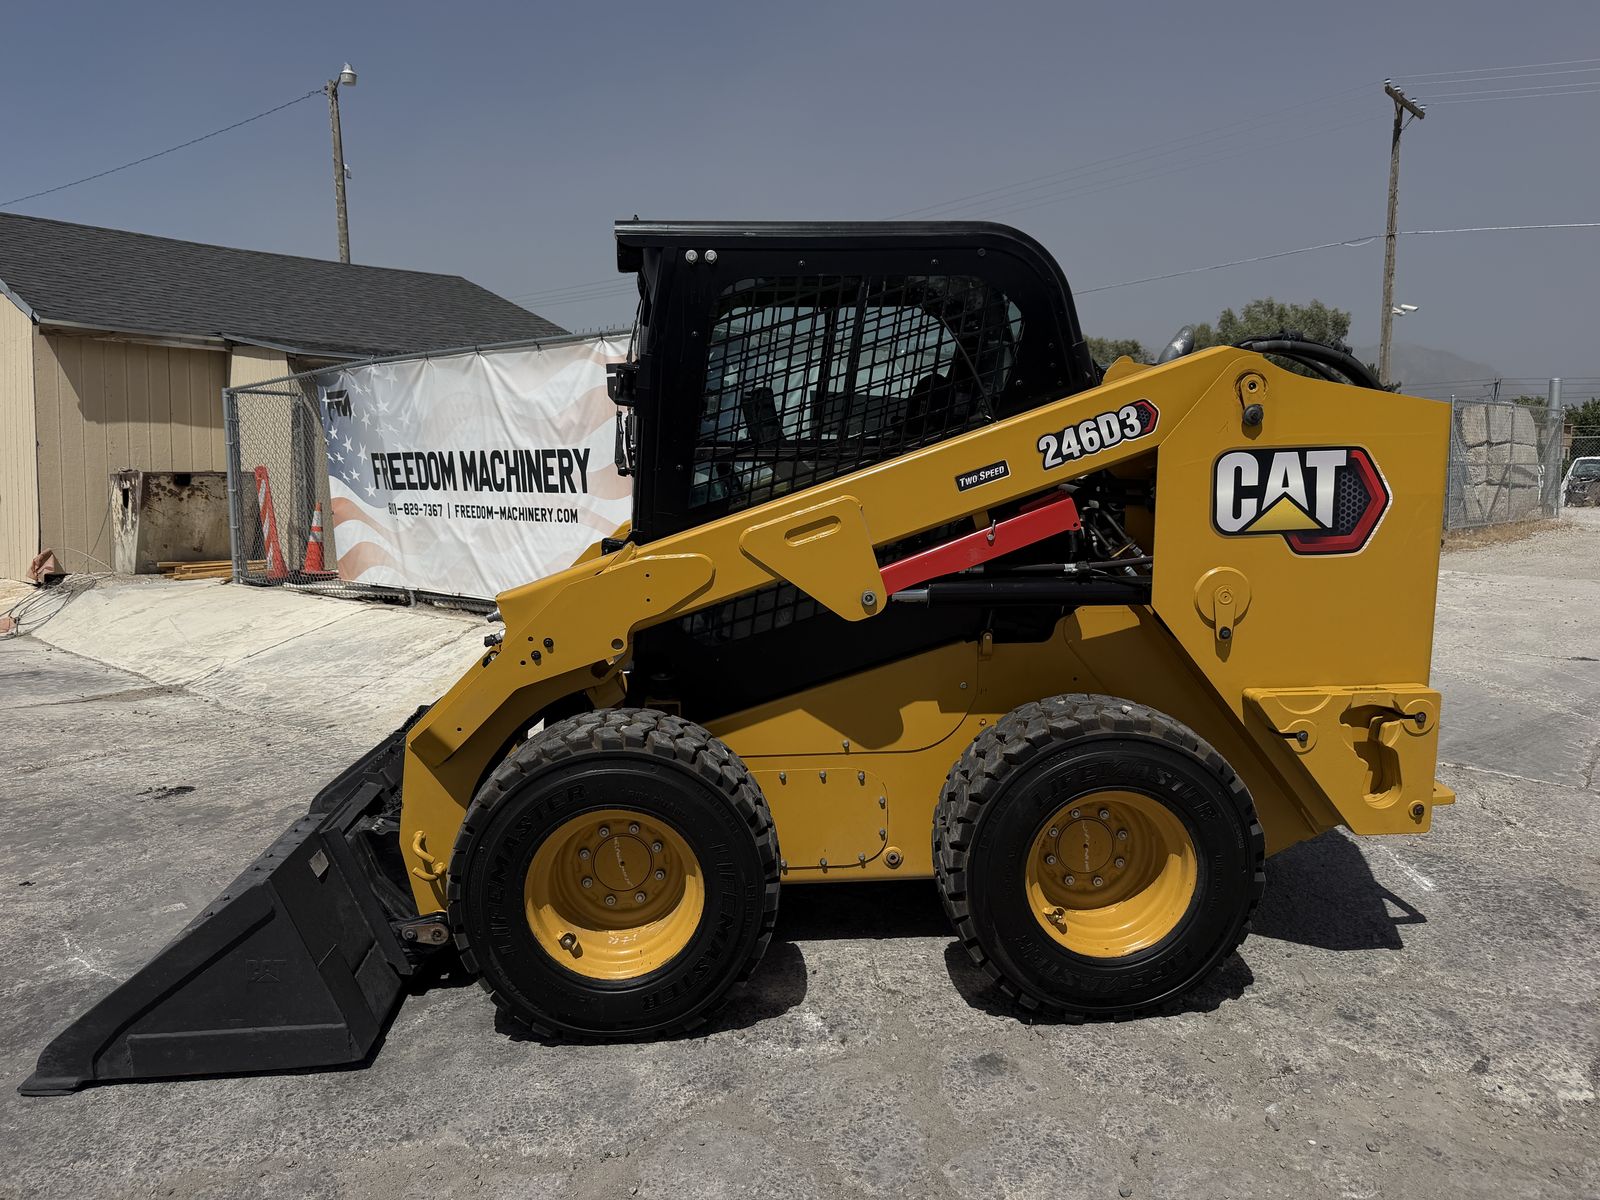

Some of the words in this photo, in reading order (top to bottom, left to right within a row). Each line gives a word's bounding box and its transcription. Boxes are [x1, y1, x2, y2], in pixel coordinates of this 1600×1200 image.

[1037, 404, 1144, 470] 246D3
[371, 451, 457, 491] FREEDOM
[460, 448, 591, 494] MACHINERY
[1217, 450, 1347, 533] CAT
[455, 504, 579, 524] FREEDOM-MACHINERY.COM
[1031, 759, 1222, 823] LIFEMASTER
